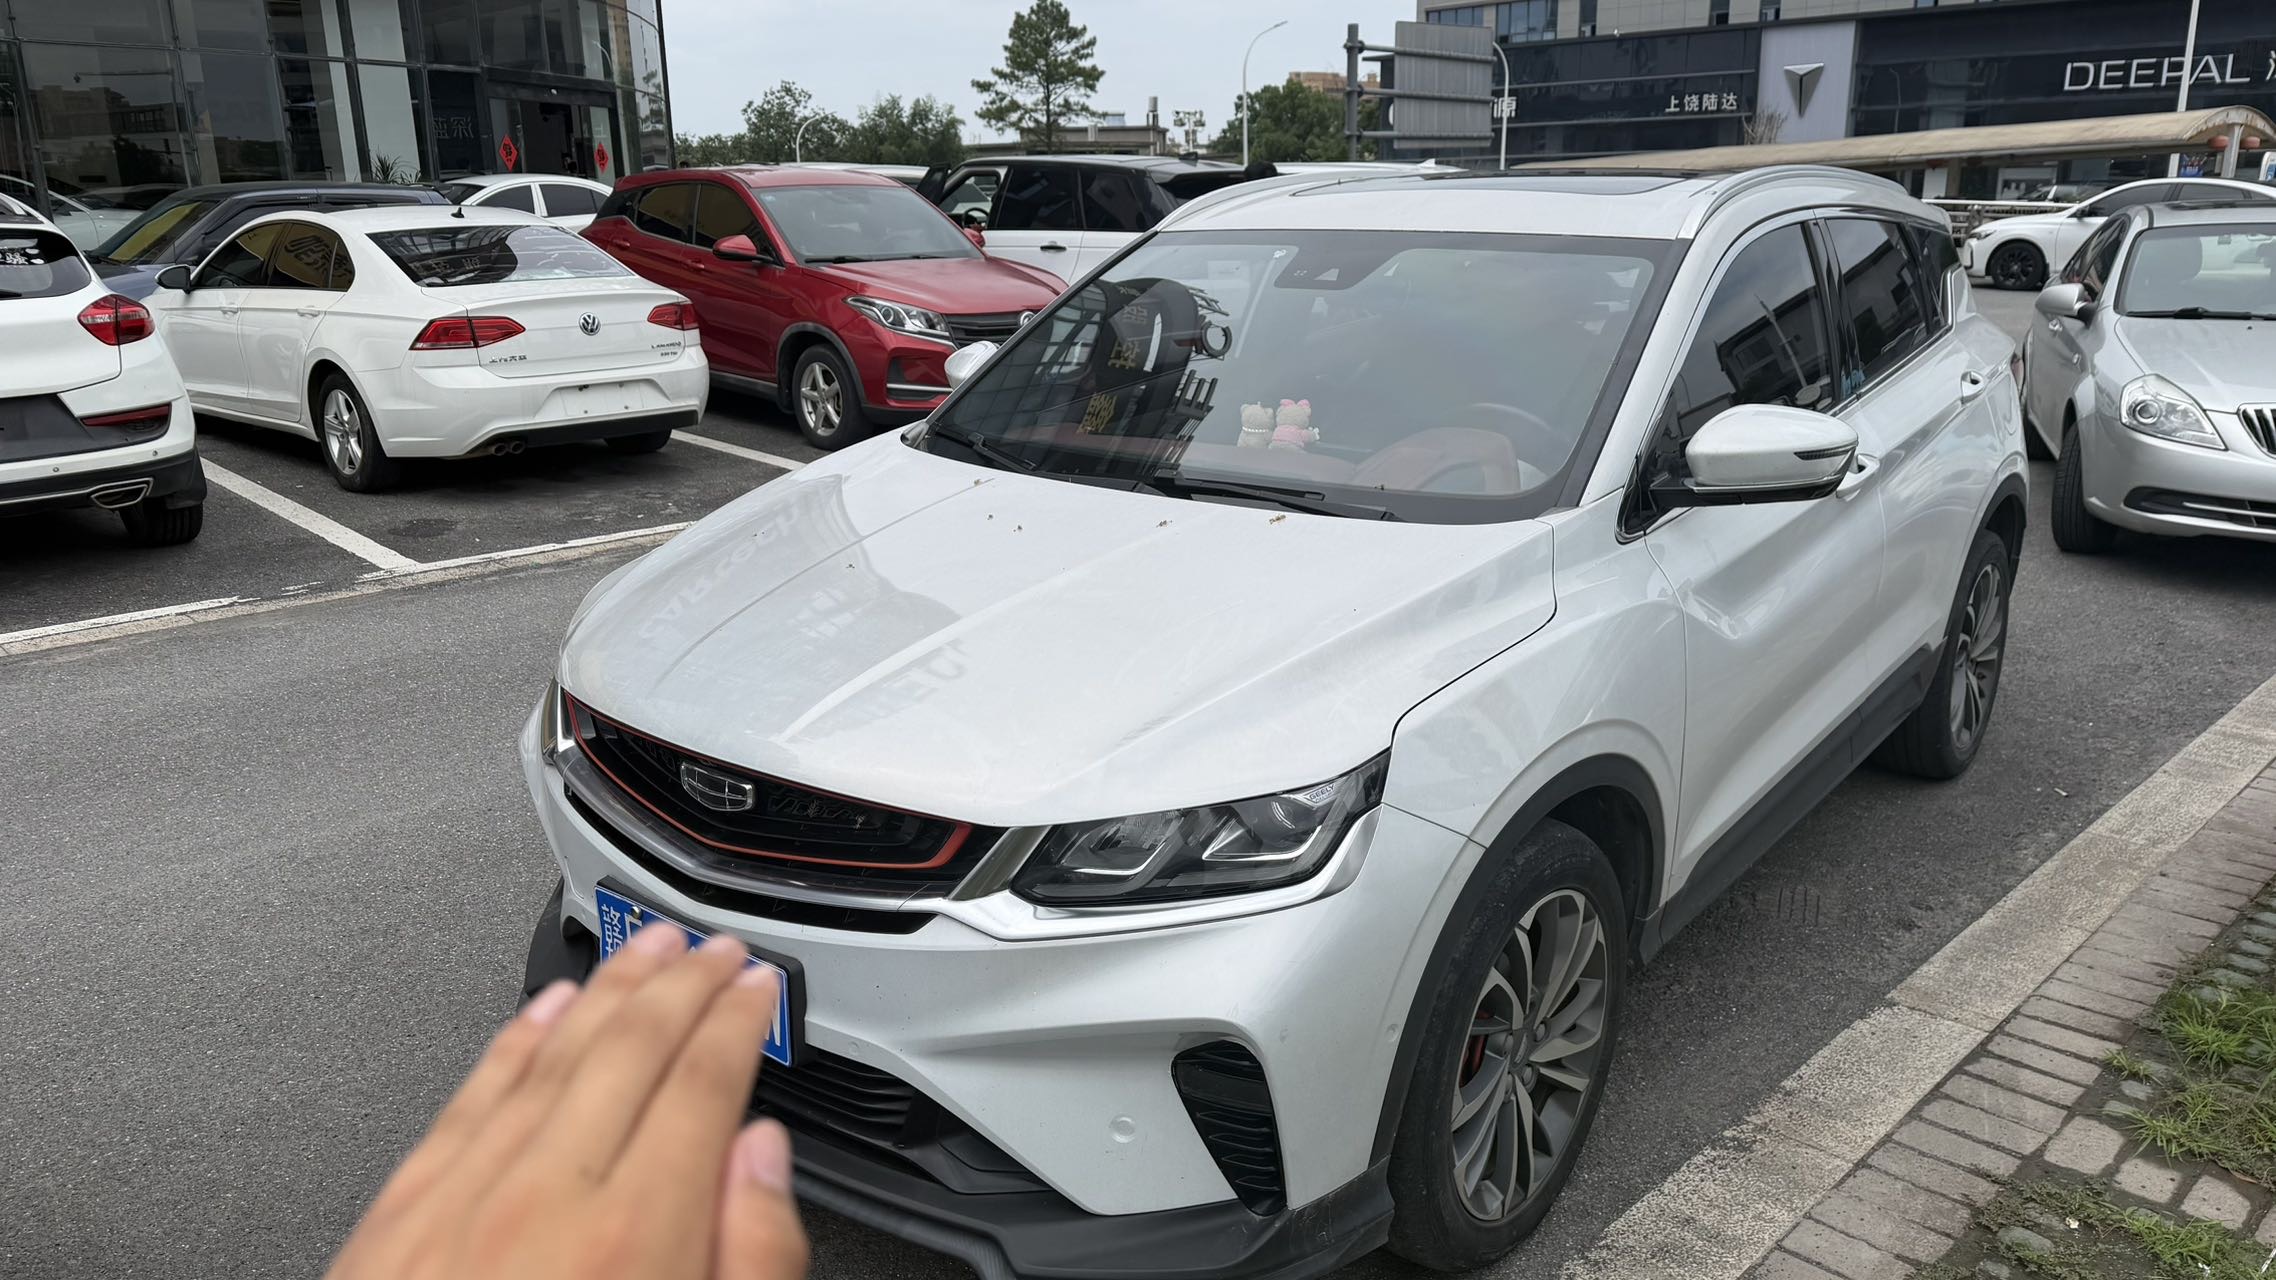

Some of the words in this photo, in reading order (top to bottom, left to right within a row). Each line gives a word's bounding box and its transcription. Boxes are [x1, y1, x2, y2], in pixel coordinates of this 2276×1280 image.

[2064, 53, 2250, 91] DEEPAL
[1665, 92, 1738, 113] 上饶陆达
[1309, 784, 1334, 800] GEELY
